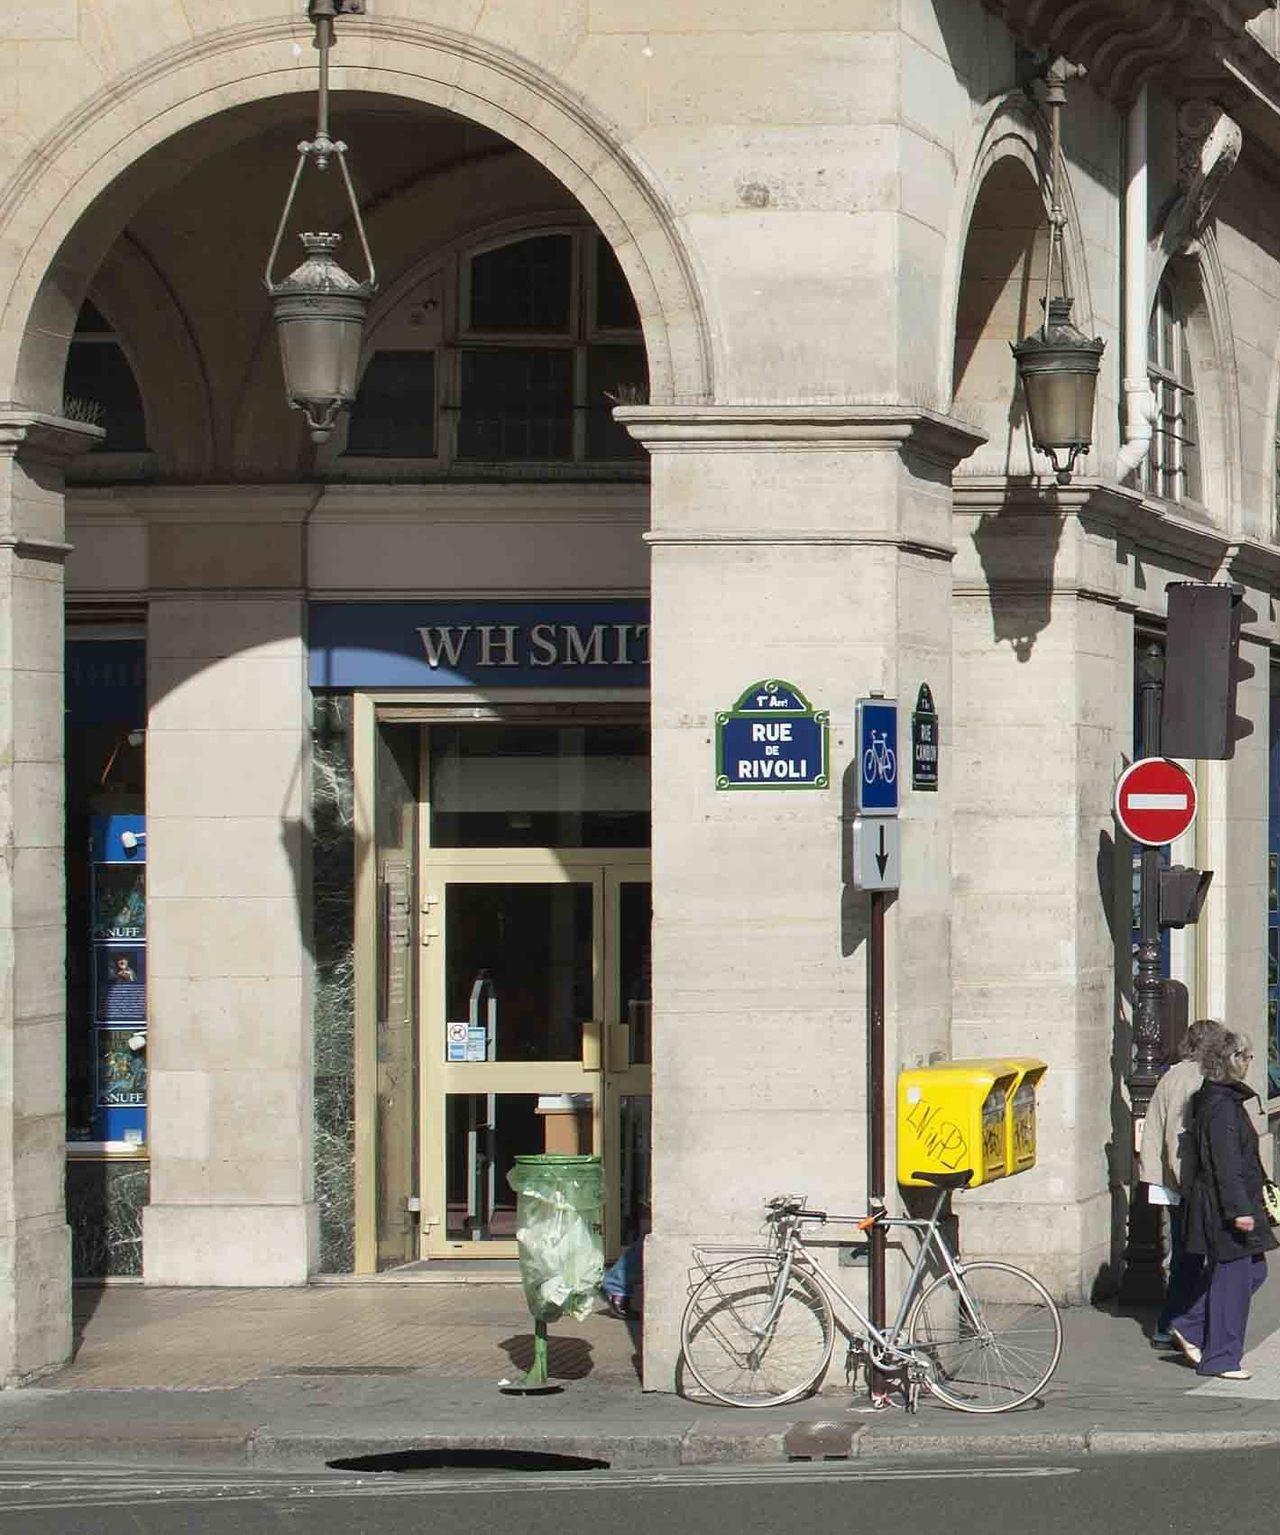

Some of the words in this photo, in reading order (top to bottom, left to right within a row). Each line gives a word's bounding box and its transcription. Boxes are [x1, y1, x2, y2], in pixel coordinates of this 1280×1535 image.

[752, 723, 793, 742] RUE
[765, 745, 780, 756] DE
[738, 759, 807, 779] RIVOLI
